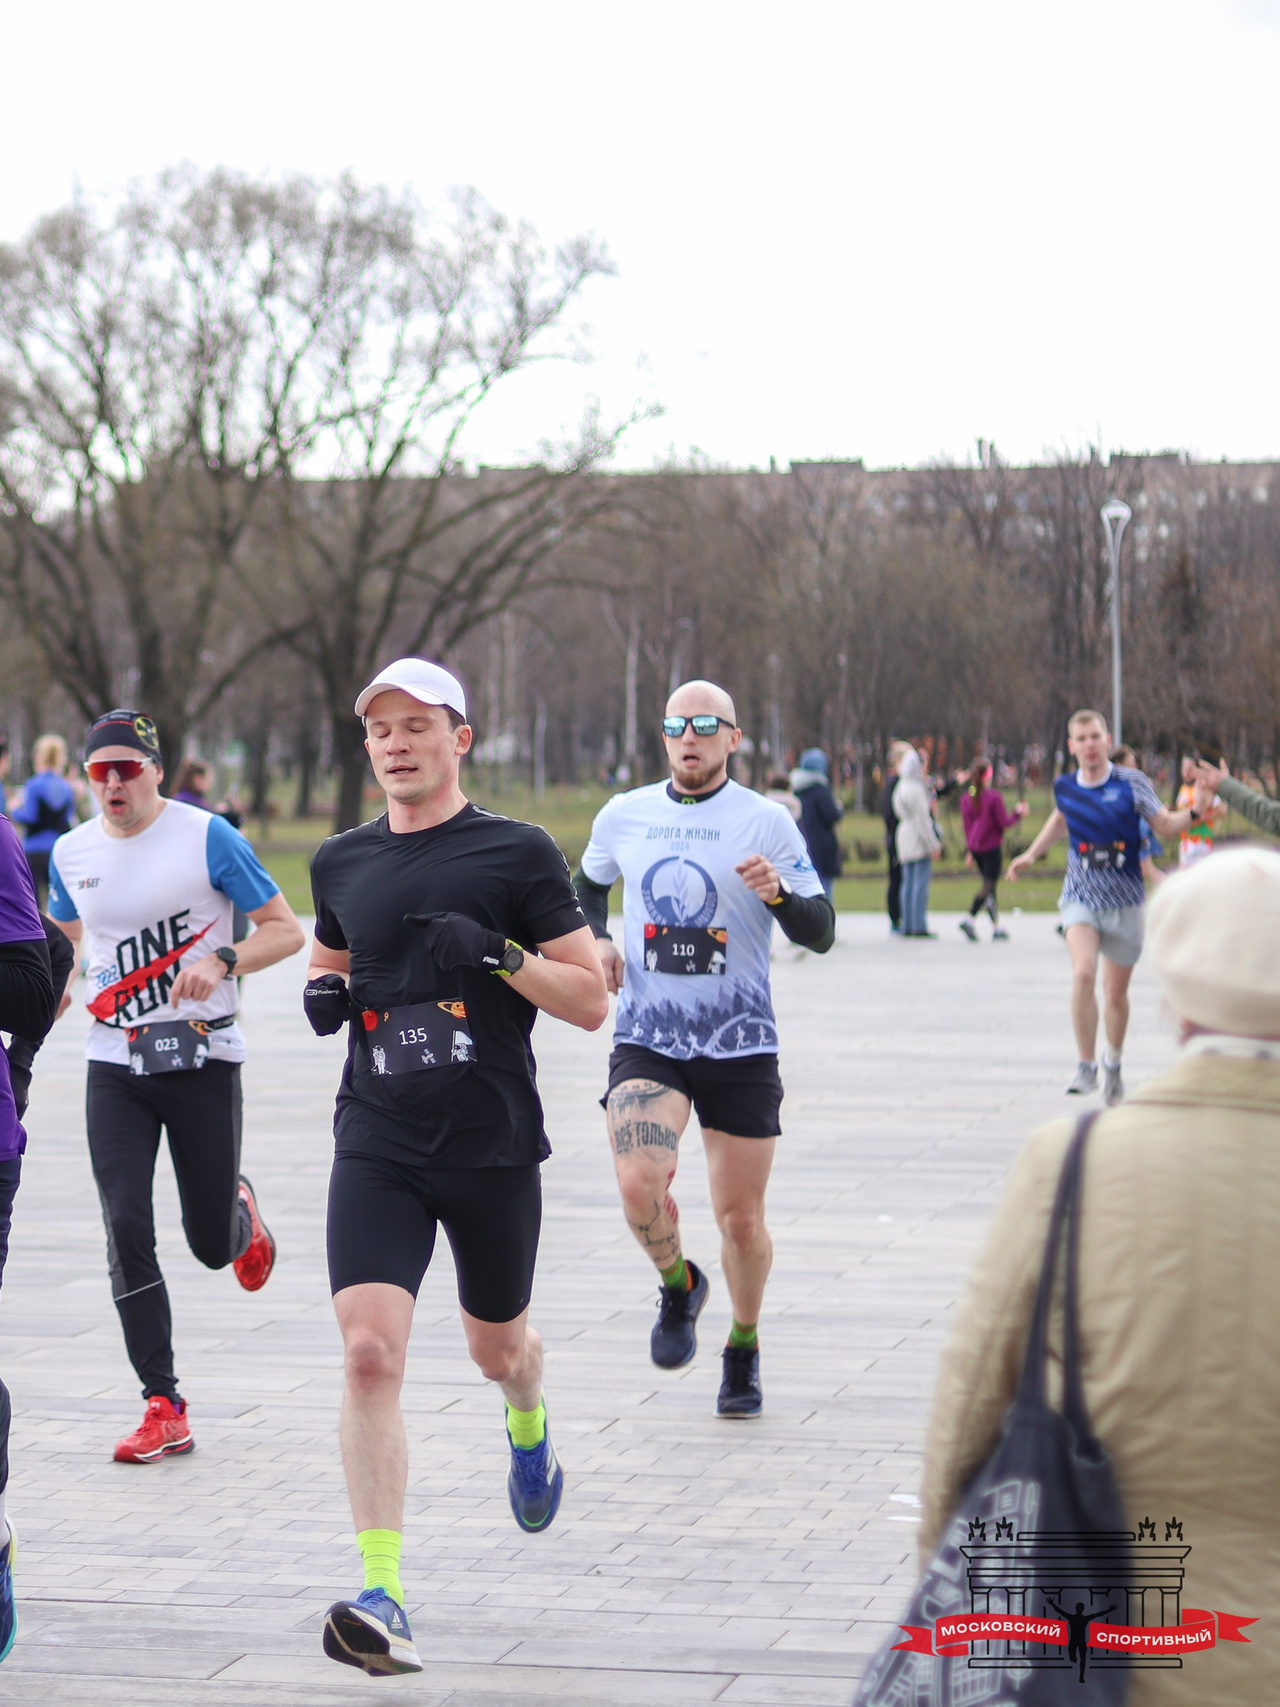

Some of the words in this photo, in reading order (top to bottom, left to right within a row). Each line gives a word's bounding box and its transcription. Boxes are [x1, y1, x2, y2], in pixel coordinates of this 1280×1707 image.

[646, 826, 681, 840] ДОРОГА
[684, 827, 721, 842] ЖИЗНИ
[116, 908, 194, 980] ONE
[672, 943, 695, 957] 110
[114, 956, 181, 1026] RUN
[154, 1037, 180, 1052] 023
[398, 1027, 428, 1045] 135
[634, 1120, 677, 1151] ТОЛЬКО
